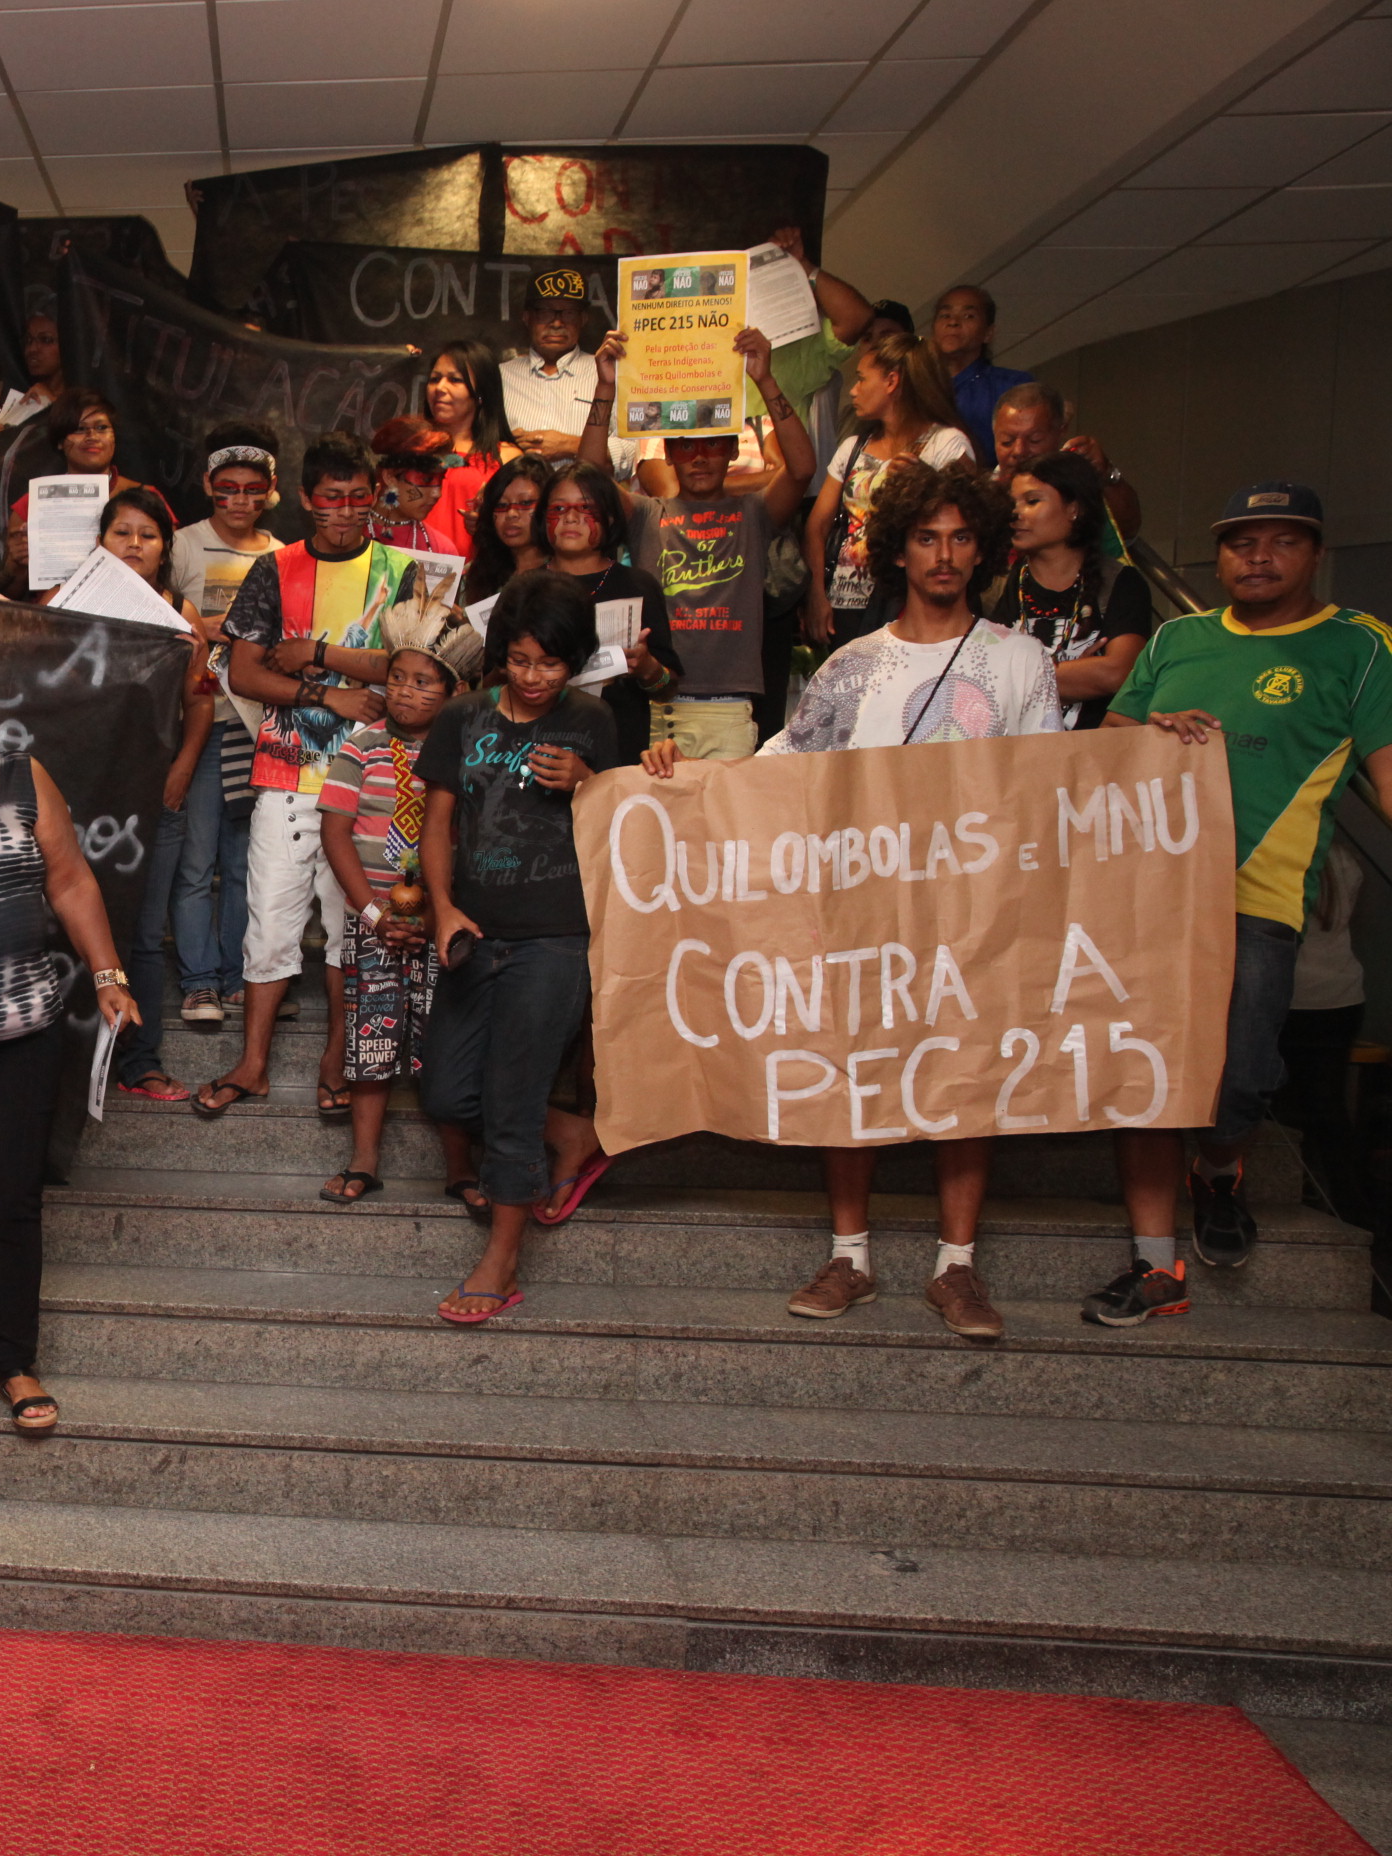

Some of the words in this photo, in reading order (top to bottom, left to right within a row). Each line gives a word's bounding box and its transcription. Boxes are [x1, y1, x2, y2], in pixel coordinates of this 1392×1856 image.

[350, 251, 616, 331] CONTA
[632, 301, 665, 311] NENHUM
[665, 299, 694, 309] DIREITO
[695, 299, 701, 308] A
[702, 297, 732, 307] MENOS!
[633, 316, 666, 332] #PEC
[669, 315, 693, 330] 215
[698, 310, 729, 329] NÃO
[645, 344, 662, 353] Pela
[663, 342, 699, 354] proteção
[700, 342, 717, 351] das:
[648, 358, 671, 367] Terras
[673, 356, 714, 367] Indígenas,
[640, 371, 663, 381] Terras
[665, 370, 716, 382] Quilombolas
[630, 385, 667, 395] Unidades
[669, 384, 678, 393] de
[681, 382, 732, 394] Conservação
[685, 527, 726, 540] DIVISION
[697, 540, 716, 552] 67
[657, 549, 745, 587] Panthers
[695, 607, 729, 618] STATE
[270, 743, 321, 765] reggae
[609, 792, 1000, 914] QUILOMBOLAS
[1056, 771, 1200, 869] MNU
[665, 938, 978, 1049] CONTRA
[1049, 921, 1130, 1015] A
[359, 1003, 395, 1016] power
[358, 1038, 398, 1052] SPEED+
[358, 1050, 397, 1065] POWER
[765, 1035, 961, 1141] PEC
[994, 1020, 1169, 1129] 215
